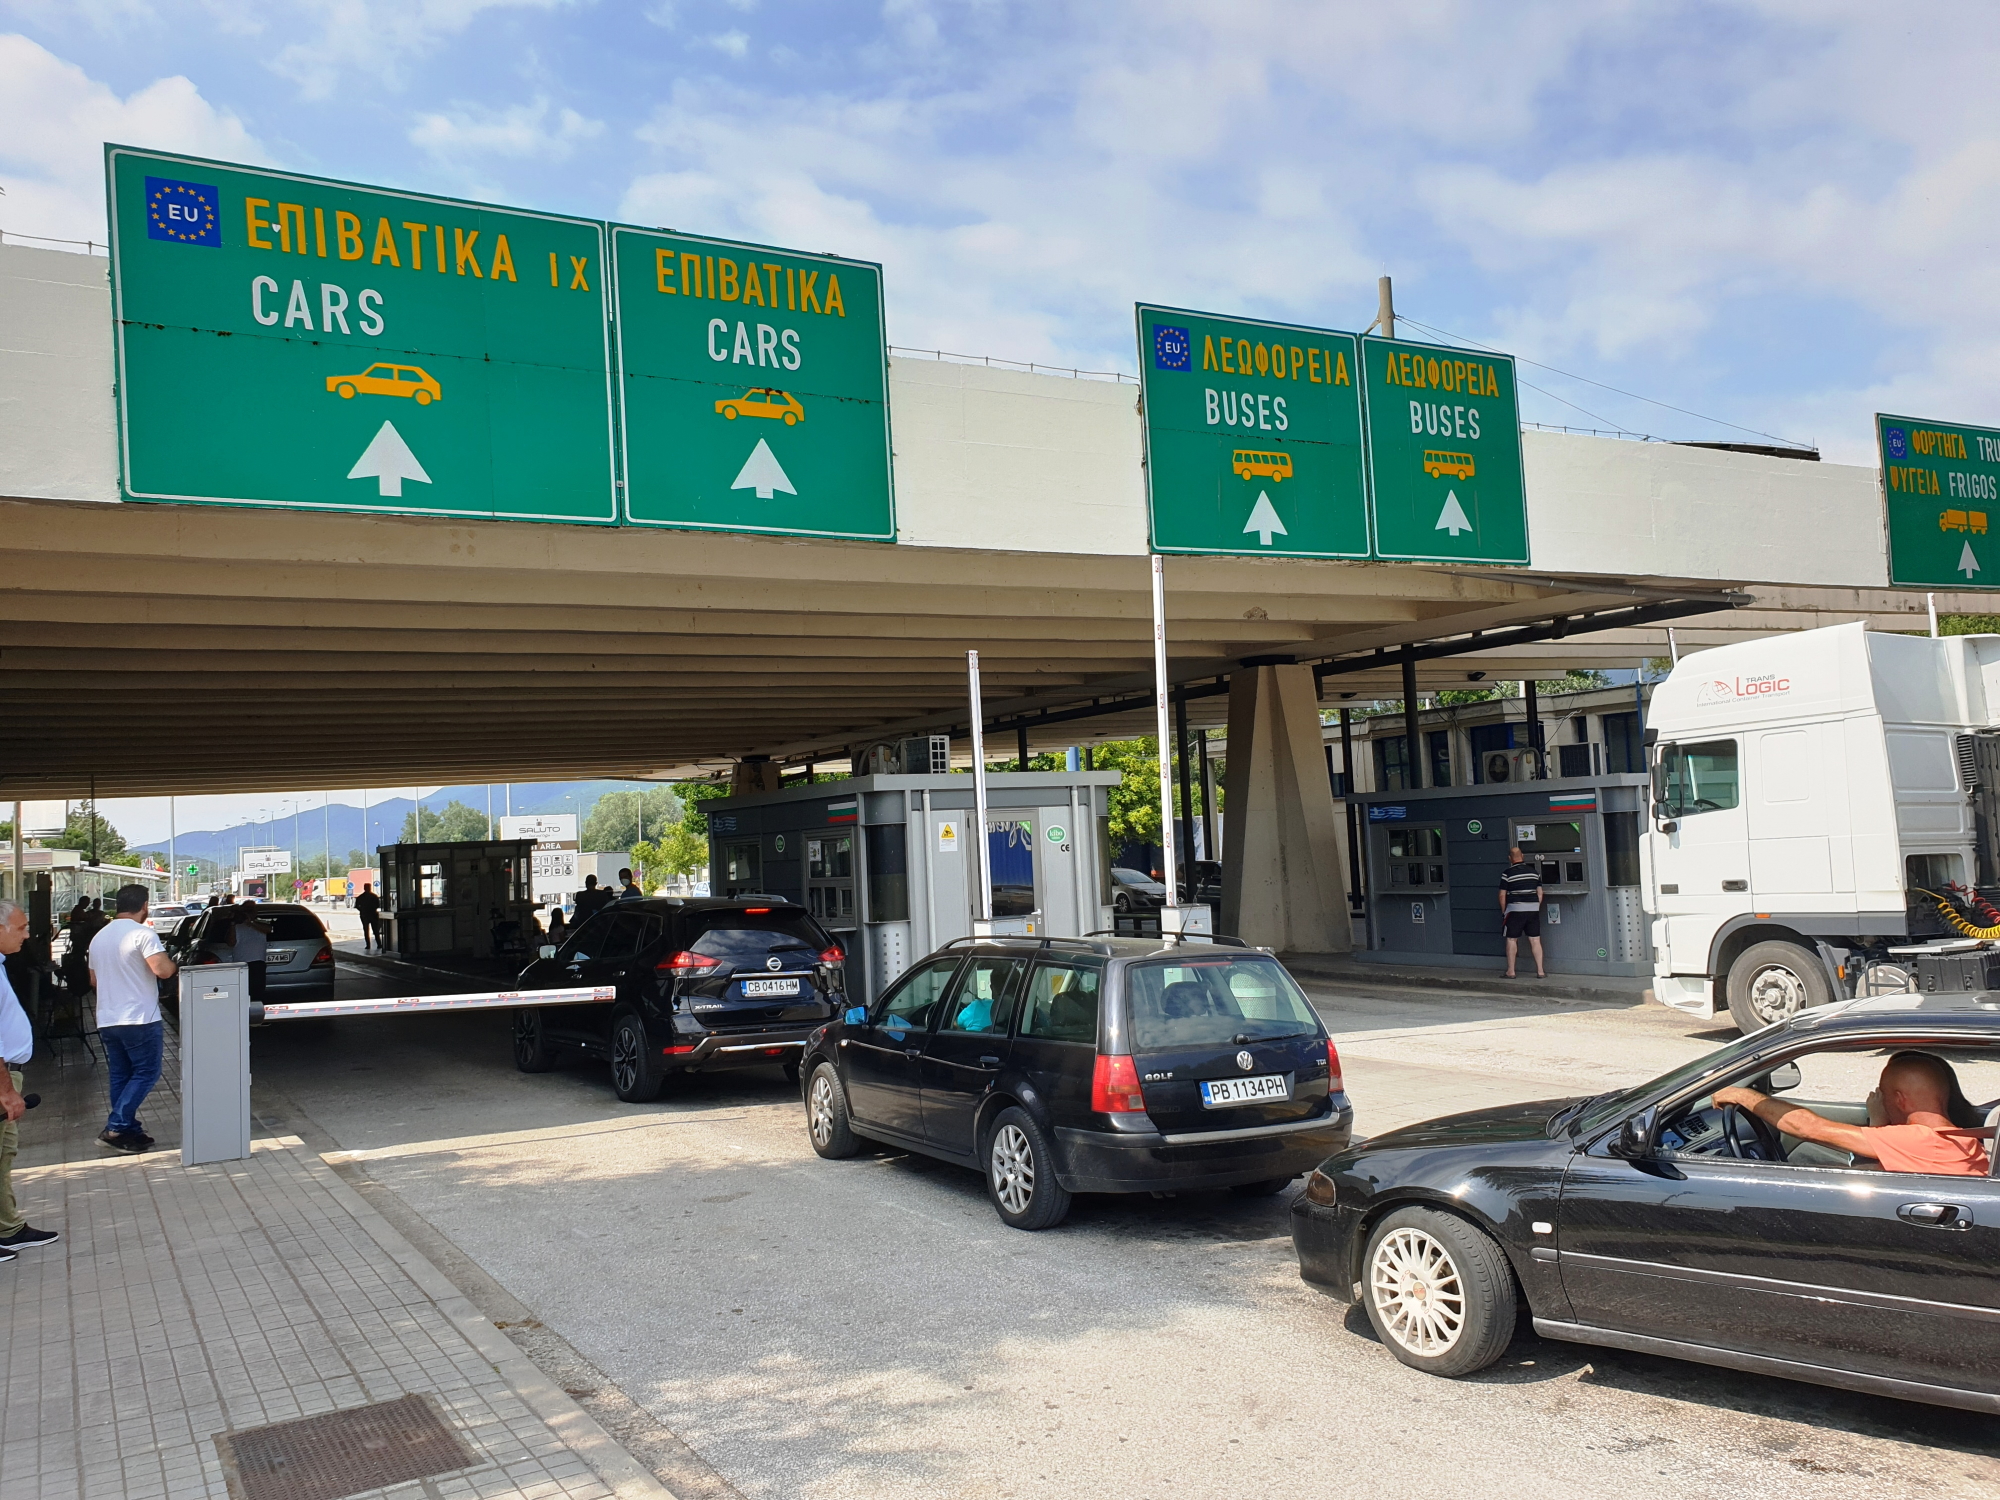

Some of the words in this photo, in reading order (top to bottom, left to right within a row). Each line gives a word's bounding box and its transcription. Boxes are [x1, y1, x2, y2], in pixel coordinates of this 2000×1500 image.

[167, 203, 199, 223] EU
[245, 196, 518, 282] ΕΠΙΒΑΤΙΚΑ
[655, 247, 846, 318] ΕΠΙΒΑΤΙΚΑ
[251, 274, 386, 337] CARS
[707, 317, 802, 371] CARS
[1164, 341, 1181, 355] EU
[1202, 334, 1351, 387] ΛΕΩΦΟΡΕΙΑ
[1385, 351, 1500, 398] ΛΕΩΦΟΡΕΙΑ
[1204, 387, 1289, 432] BUSES
[1409, 400, 1481, 440] BUSES
[1892, 438, 1902, 448] EU
[1912, 428, 1968, 459] ΦΟΡΤΗΓΑ
[1889, 465, 1941, 496] ΨΥΓΕΙΑ
[1948, 471, 1998, 500] FRIGOS
[1745, 674, 1776, 684] TRANS
[1731, 694, 1760, 703] Container
[1762, 690, 1791, 699] Transport
[518, 826, 561, 834] SALUTO
[1049, 829, 1063, 837] kibo
[540, 842, 562, 850] AREA
[1060, 843, 1070, 852] CE
[248, 861, 289, 869] SALUTO
[748, 982, 761, 993] CB
[762, 980, 785, 991] 0416
[786, 979, 799, 990] HM
[1315, 1058, 1327, 1066] TDI
[1144, 1072, 1173, 1081] GOLF
[1210, 1083, 1230, 1101] PB
[1232, 1078, 1265, 1099] 1134
[1265, 1077, 1285, 1095] PH
